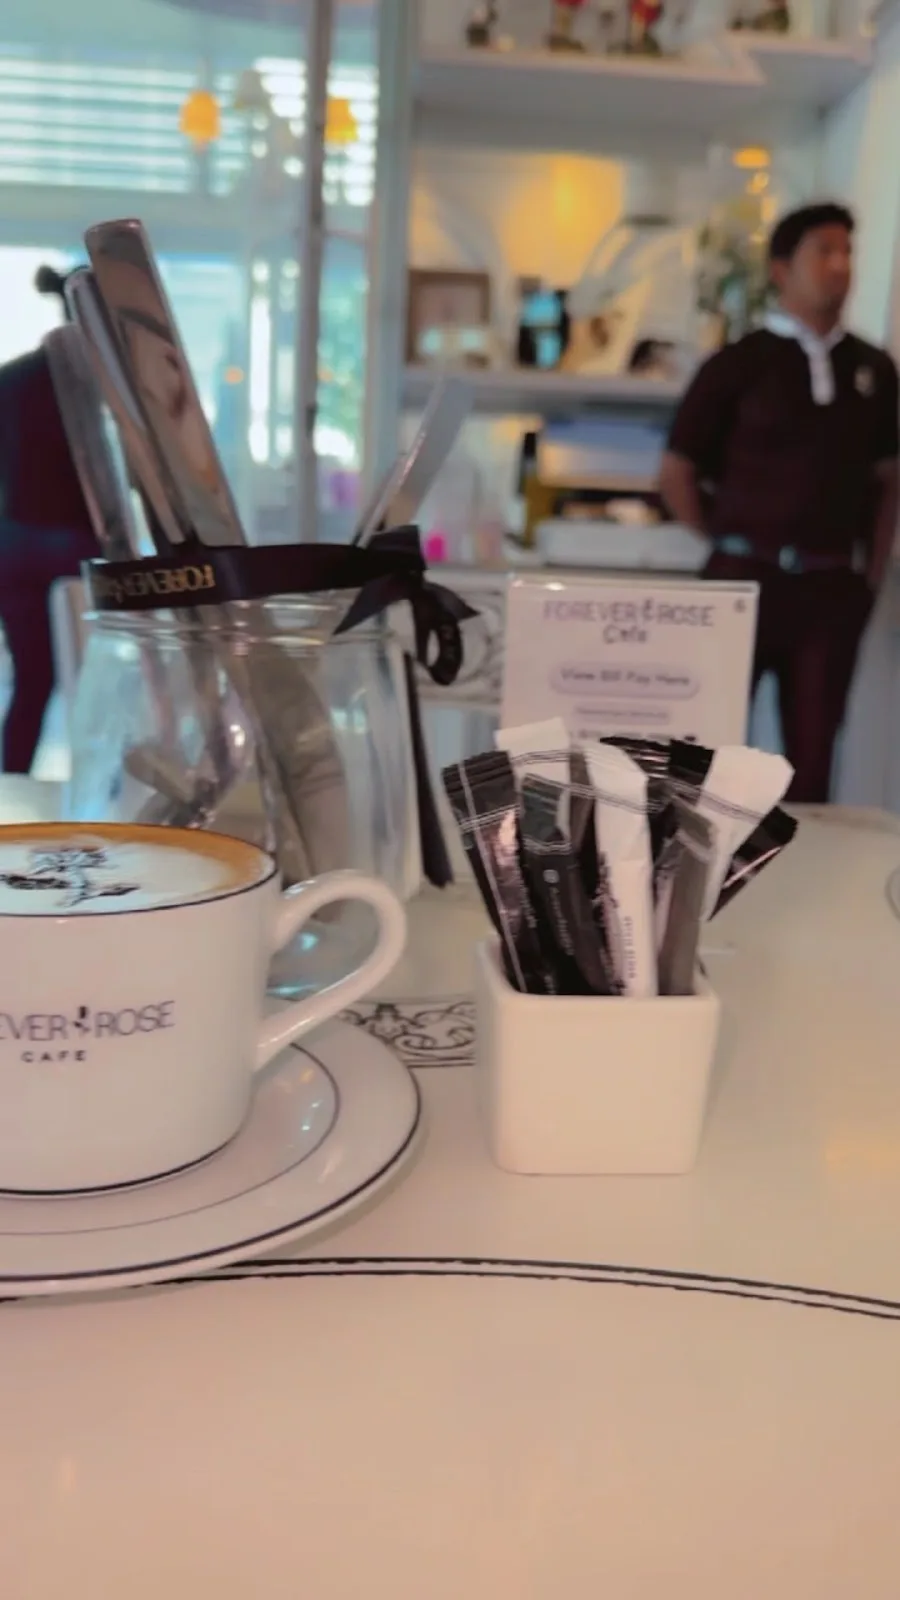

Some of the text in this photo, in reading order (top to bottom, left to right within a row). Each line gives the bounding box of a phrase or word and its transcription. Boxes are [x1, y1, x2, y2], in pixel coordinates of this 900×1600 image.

[543, 600, 715, 627] FOREVER ROSE
[94, 1000, 176, 1038] ROSE
[20, 1049, 86, 1063] CAFE
